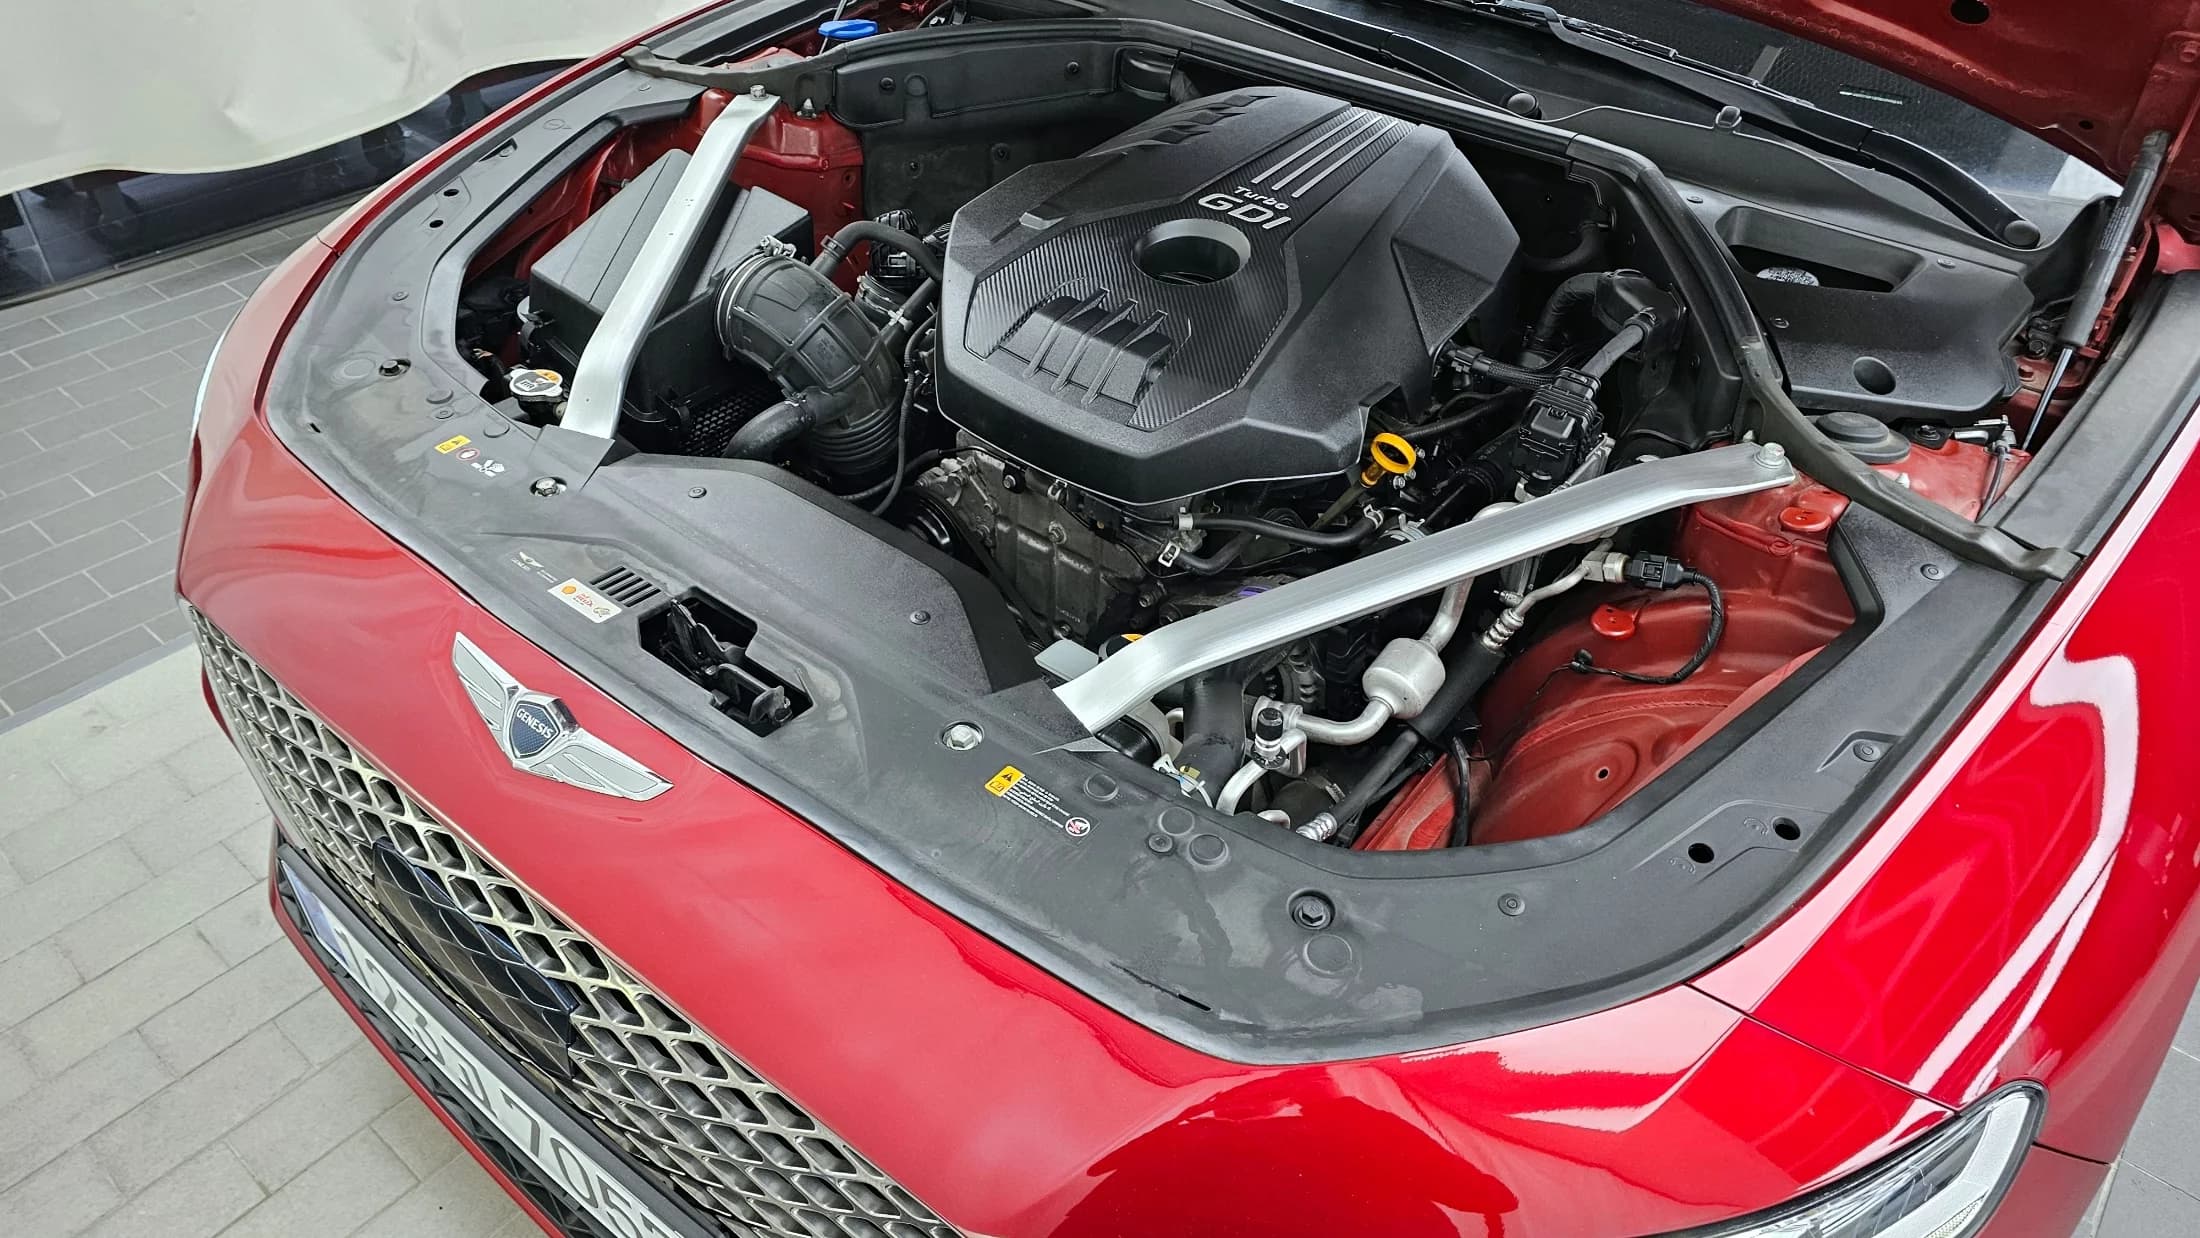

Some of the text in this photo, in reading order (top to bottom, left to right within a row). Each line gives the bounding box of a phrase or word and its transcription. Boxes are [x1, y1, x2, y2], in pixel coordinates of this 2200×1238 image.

[1198, 193, 1292, 230] GDI
[1234, 186, 1290, 209] Turbo
[516, 708, 554, 739] GENESIS
